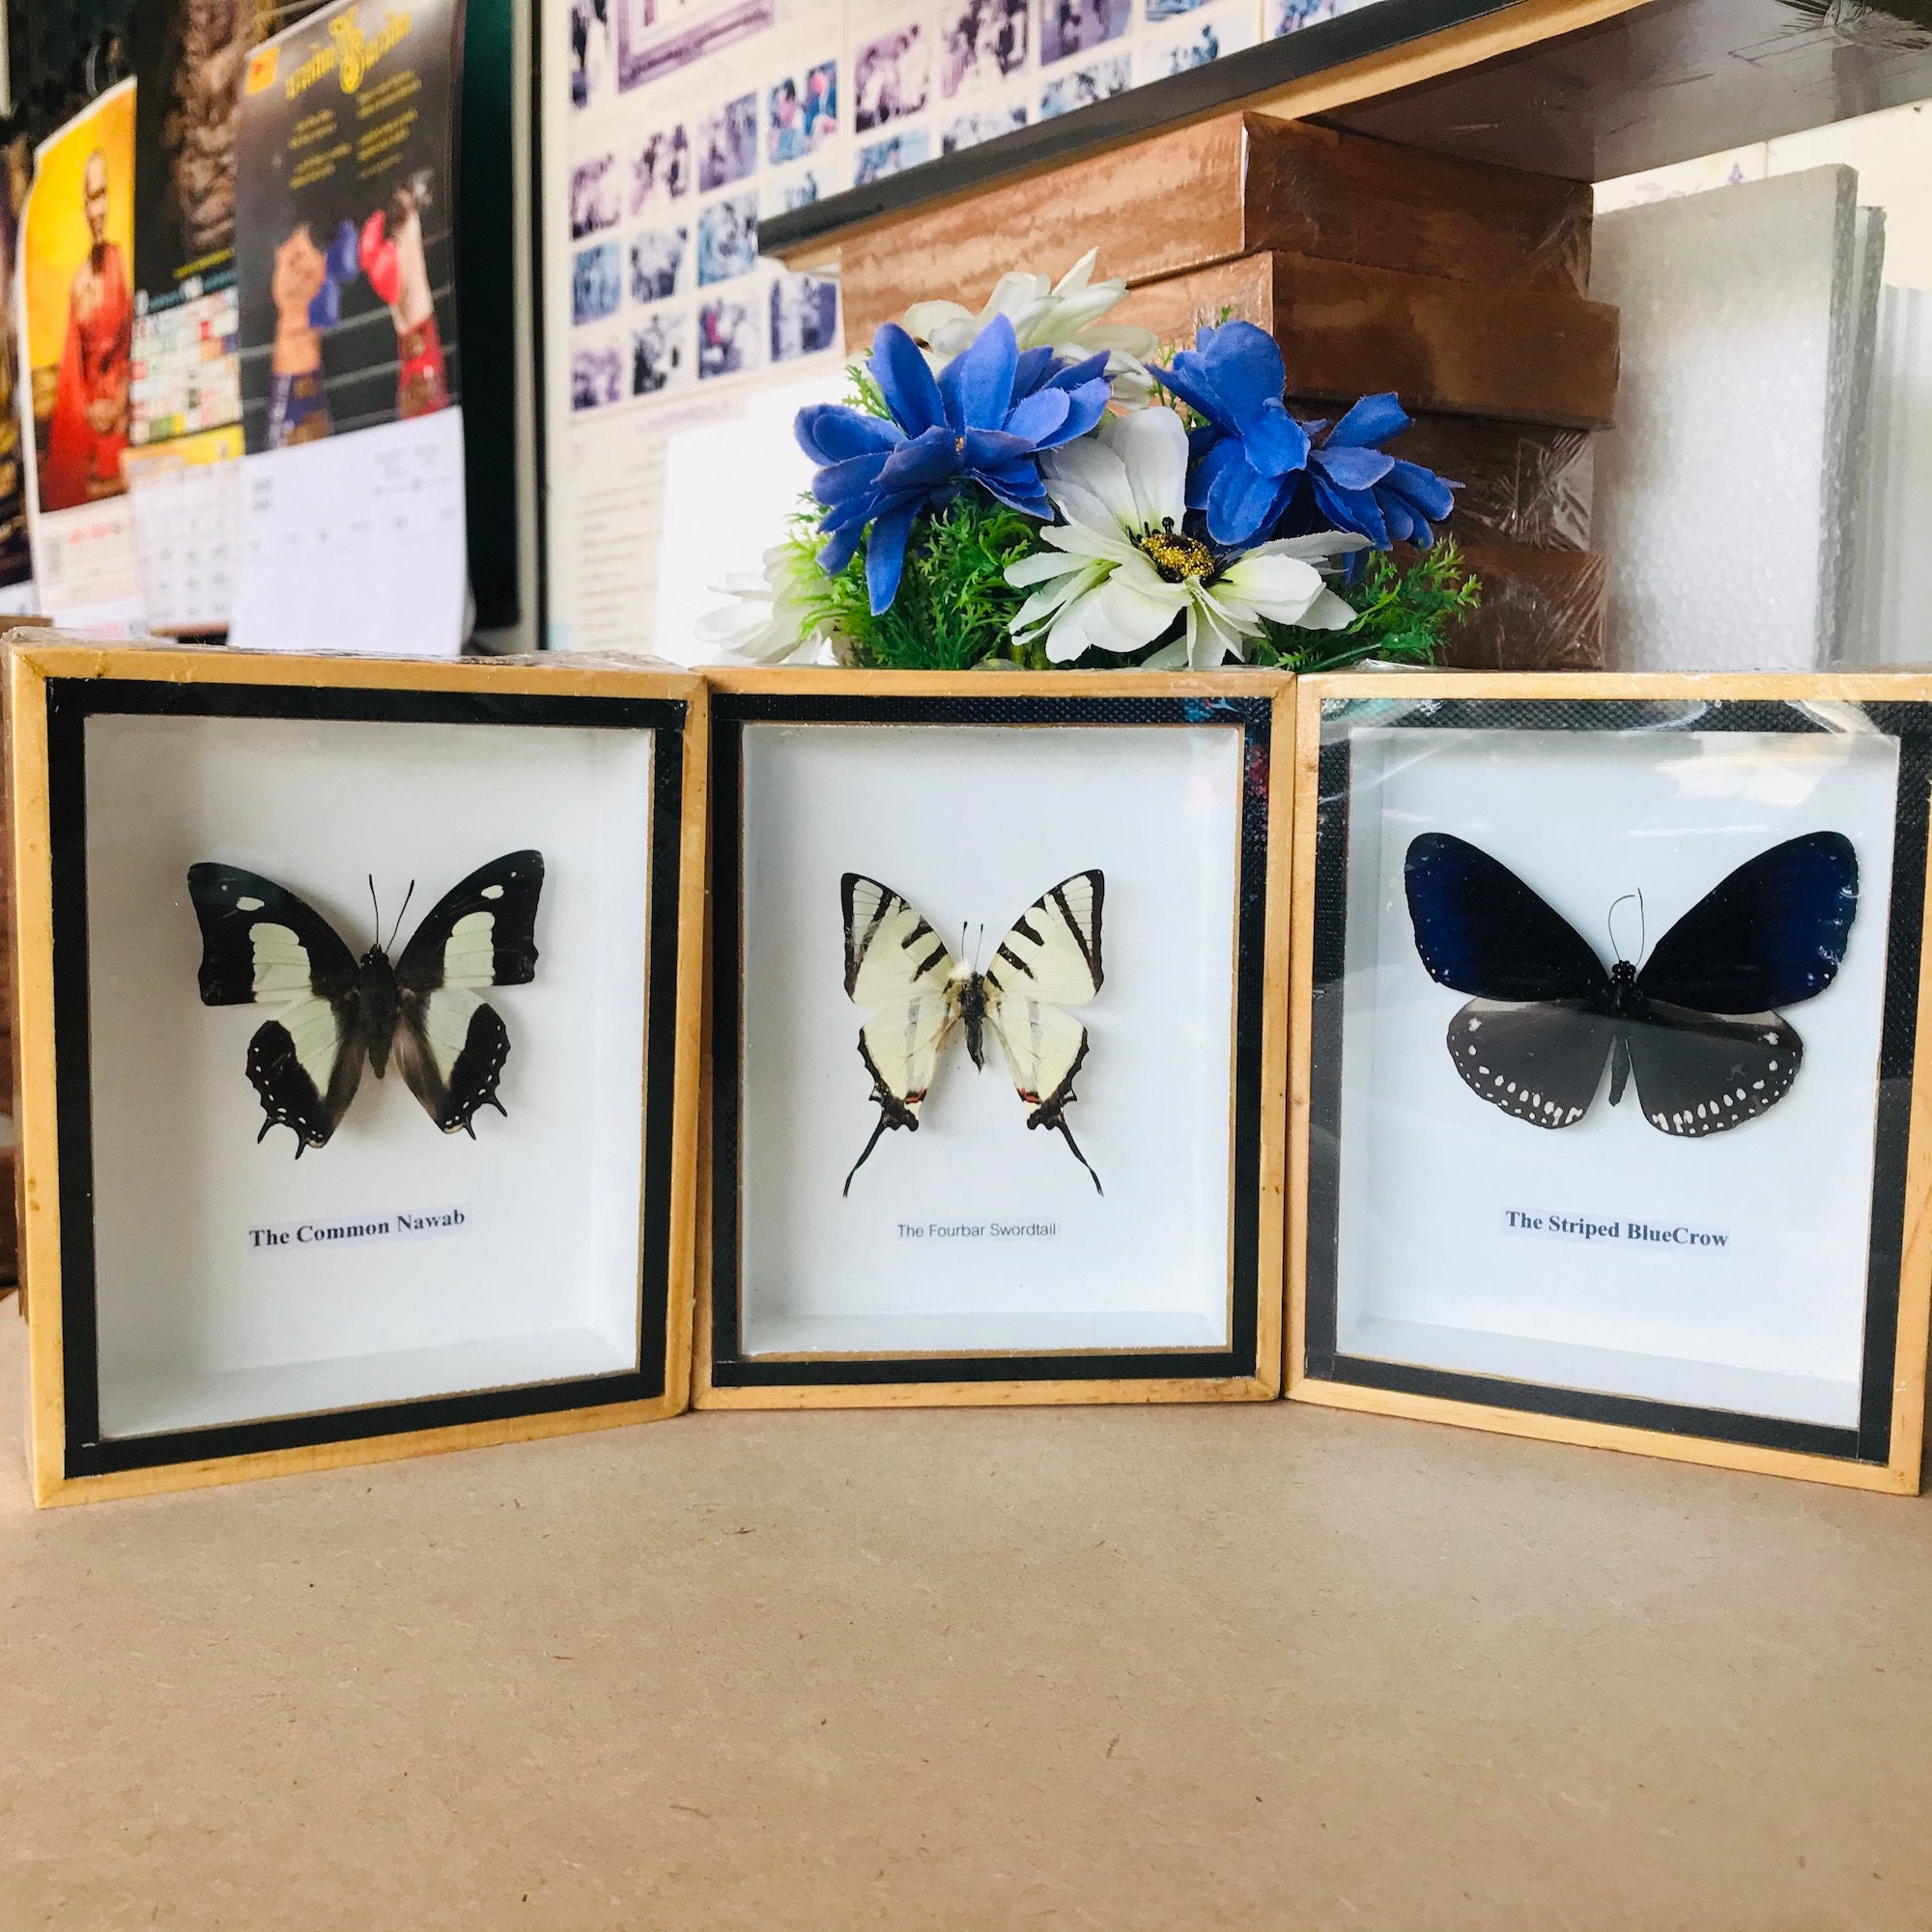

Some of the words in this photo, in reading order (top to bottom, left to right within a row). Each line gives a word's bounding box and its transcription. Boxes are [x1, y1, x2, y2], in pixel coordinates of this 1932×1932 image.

[249, 1230, 290, 1247] The
[297, 1221, 389, 1243] Common
[397, 1209, 465, 1233] Nawab
[897, 1224, 924, 1237] The
[929, 1223, 985, 1237] Fourbar
[990, 1222, 1057, 1236] Swordtail
[1506, 1210, 1543, 1230] The
[1548, 1215, 1620, 1239] Striped
[1628, 1223, 1728, 1247] BlueCrow
